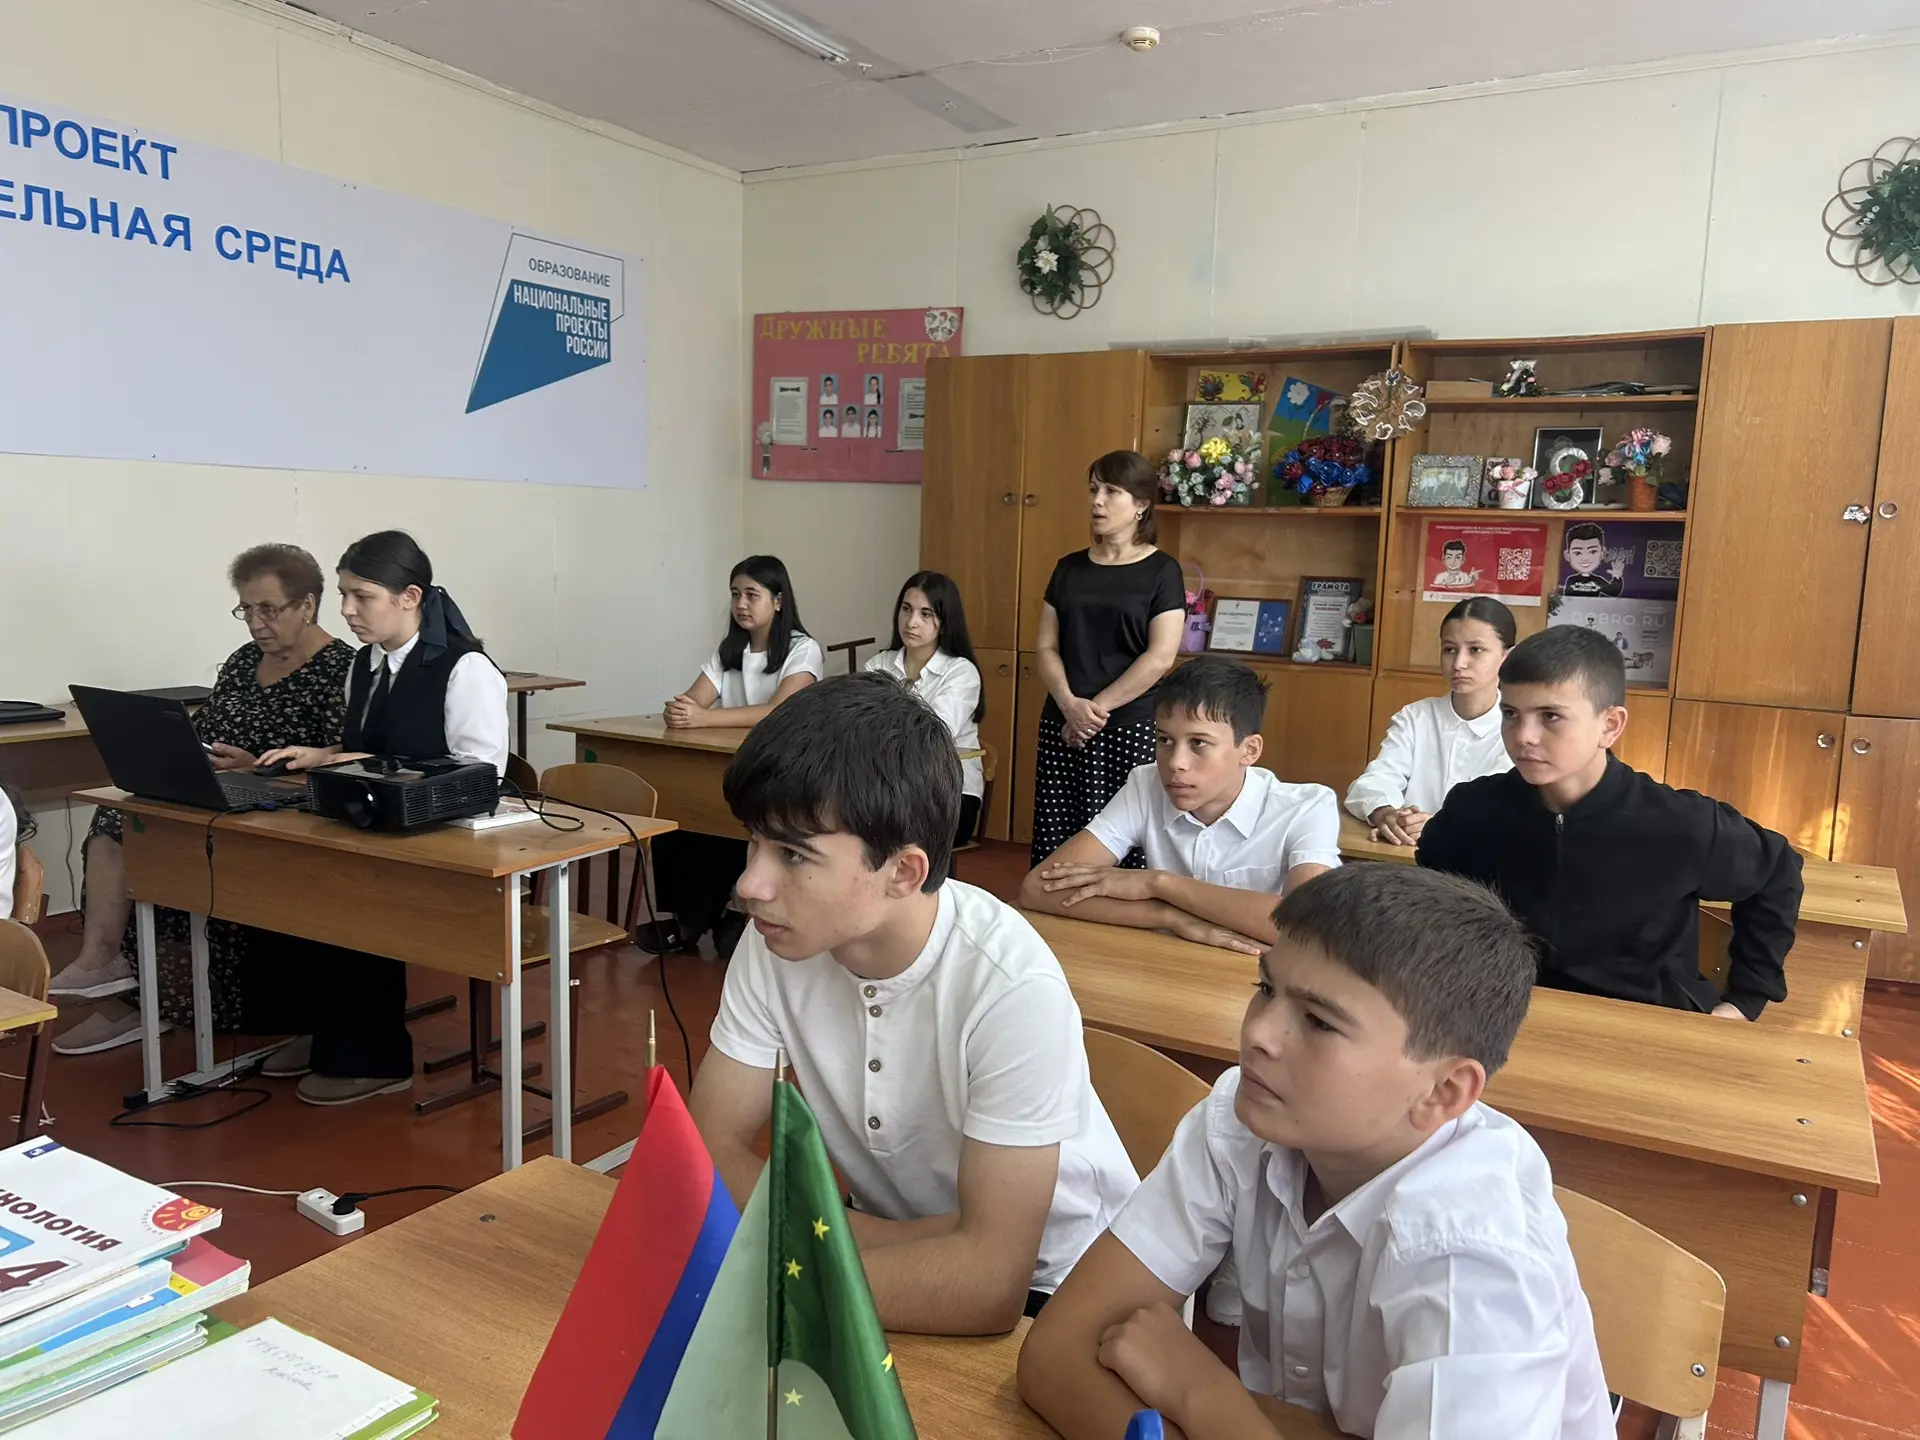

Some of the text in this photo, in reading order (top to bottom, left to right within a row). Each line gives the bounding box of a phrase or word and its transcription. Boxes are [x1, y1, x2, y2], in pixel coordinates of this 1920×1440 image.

[0, 104, 178, 181] ПРОЕКТ
[0, 179, 351, 284] ЕЛЬНАЯ СРЕДА
[528, 258, 611, 287] ОБРАЗОВАНИЕ
[513, 284, 608, 320] НАЦИОНАЛЬНЫЕ
[556, 313, 608, 340] ПРОЕКТЫ
[760, 316, 886, 340] ДРУЖНЫЕ
[566, 335, 608, 359] РОССИИ
[857, 342, 951, 364] РЕБЯТА
[1312, 582, 1350, 591] ГРАМОТА
[1572, 612, 1666, 627] DOBRO.RU
[0, 1188, 123, 1252] НОЛОГИЯ
